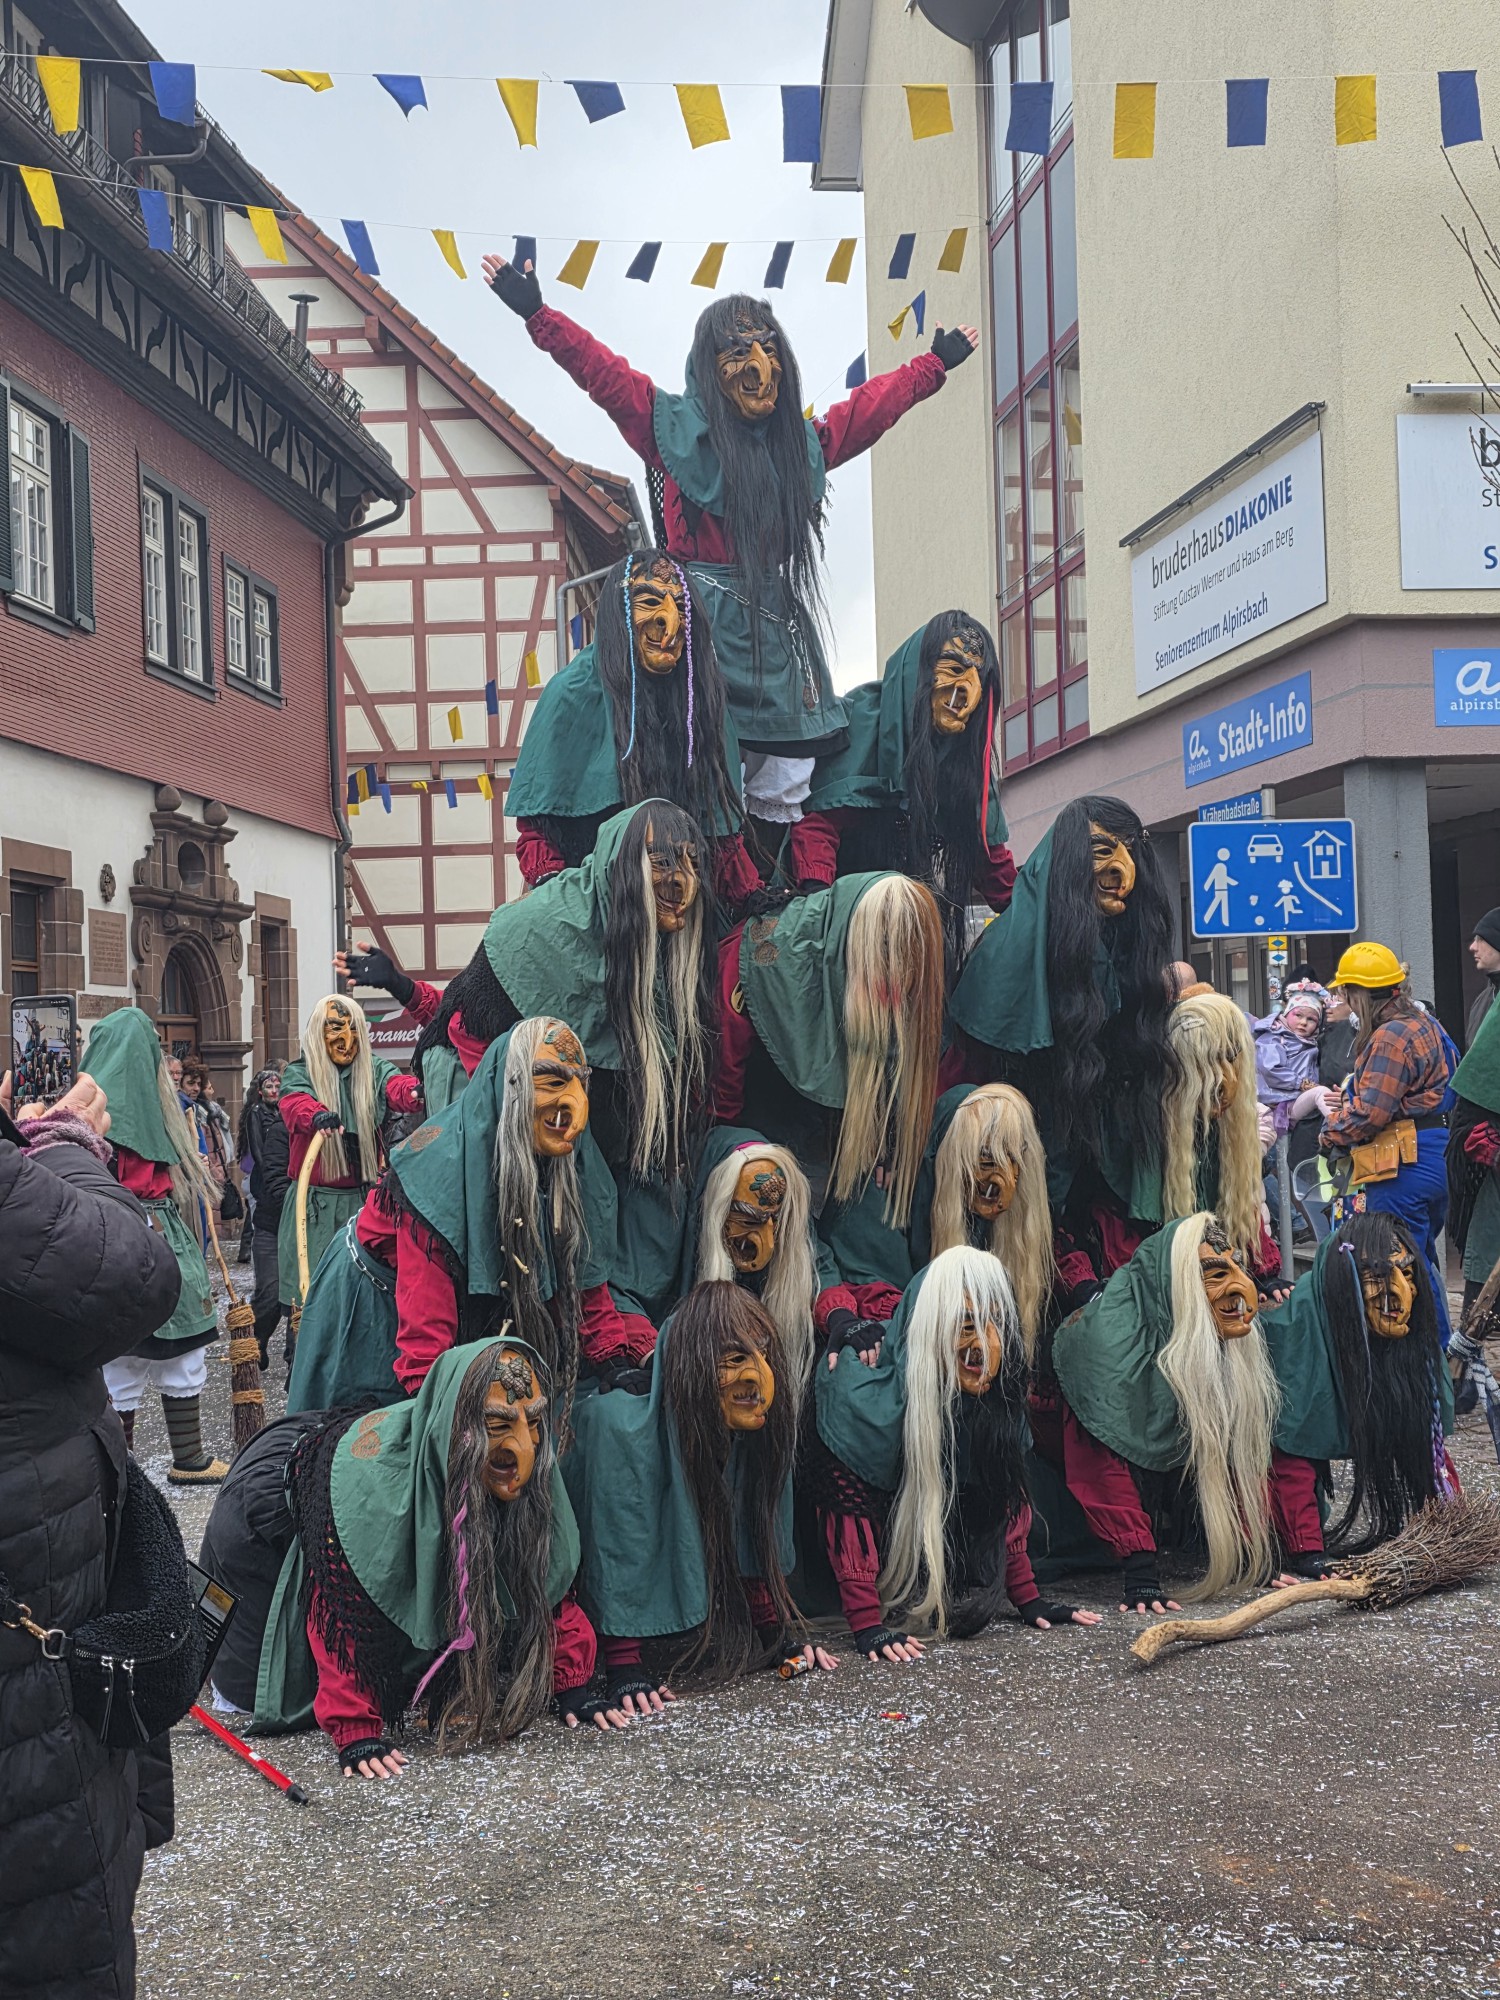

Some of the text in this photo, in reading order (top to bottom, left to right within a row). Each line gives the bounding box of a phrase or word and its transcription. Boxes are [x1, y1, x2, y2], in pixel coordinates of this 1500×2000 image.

[1152, 474, 1293, 589] bruderhausDIAKONIE
[1153, 526, 1294, 621] Stiftung Gustav Werner und Haus am Berg
[1155, 591, 1268, 671] Seniorenzentrum Alpirsbach
[1218, 691, 1306, 762] Stadt-Info
[1450, 697, 1500, 714] alpirsb
[1202, 797, 1260, 822] Krähenbadstraße
[366, 1022, 424, 1043] aramel
